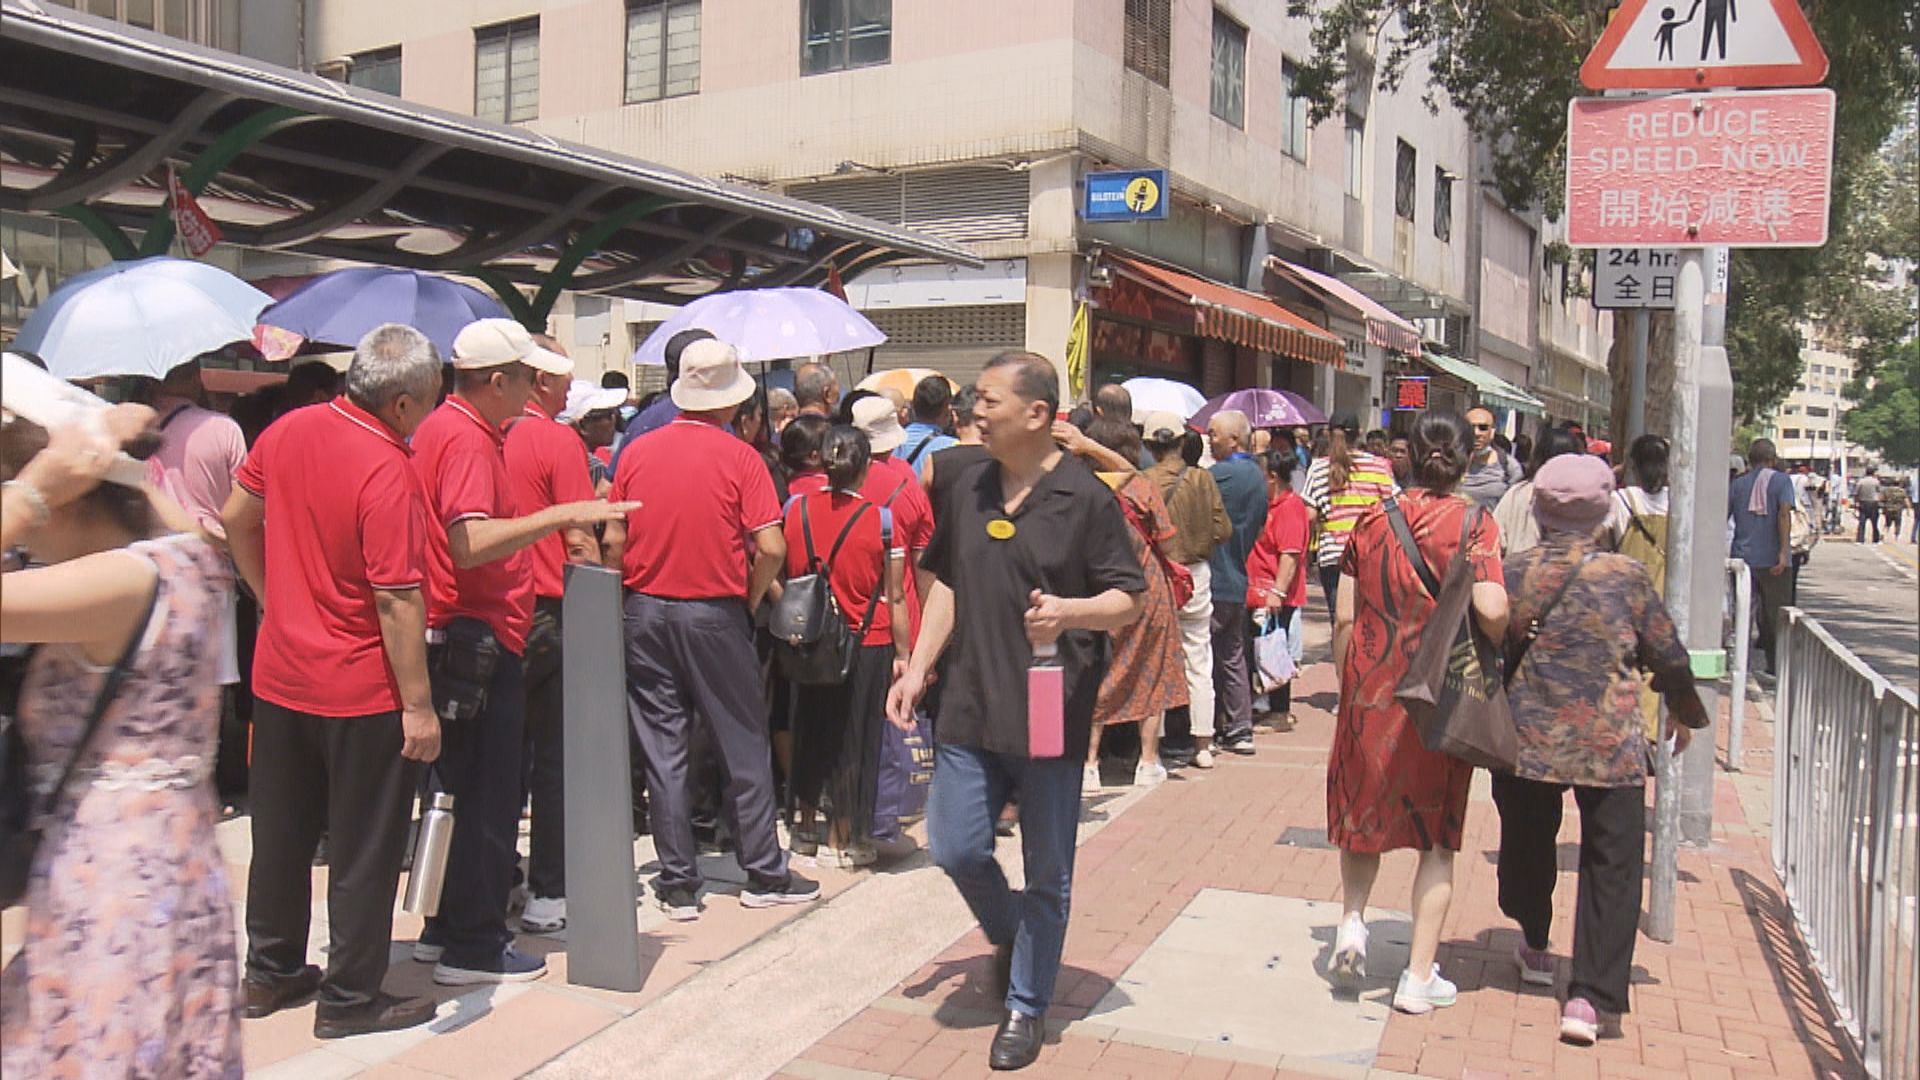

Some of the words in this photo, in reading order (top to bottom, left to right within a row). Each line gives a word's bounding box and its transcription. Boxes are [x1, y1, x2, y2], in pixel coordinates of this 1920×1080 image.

[1627, 108, 1769, 138] REDUCE
[1590, 144, 1698, 173] SPEED
[1722, 143, 1810, 170] NOW
[1608, 248, 1641, 267] 24
[1614, 274, 1674, 301] 全日
